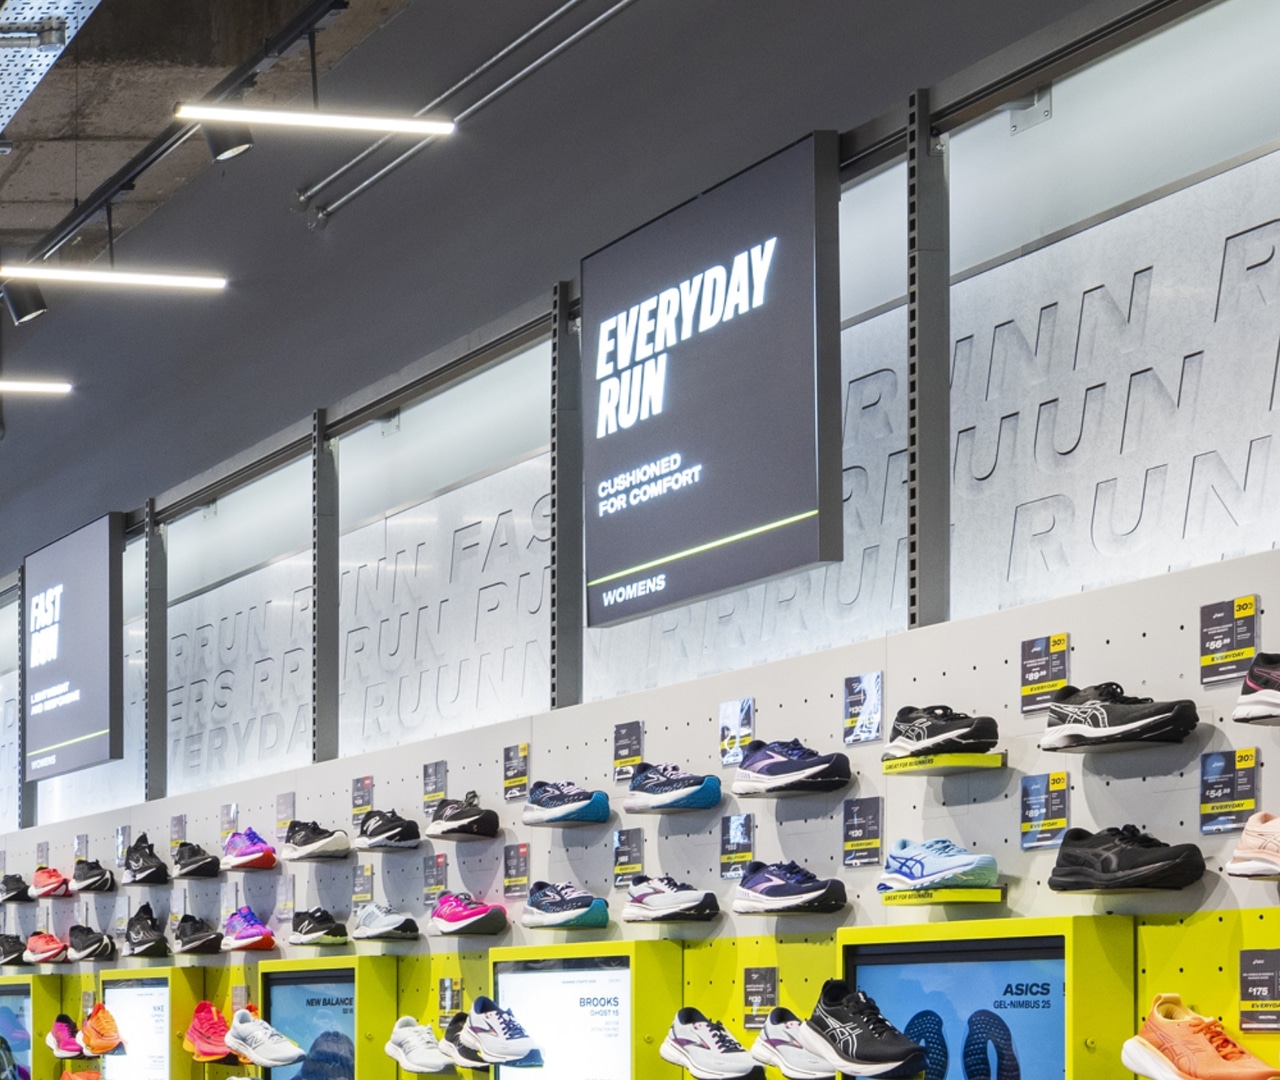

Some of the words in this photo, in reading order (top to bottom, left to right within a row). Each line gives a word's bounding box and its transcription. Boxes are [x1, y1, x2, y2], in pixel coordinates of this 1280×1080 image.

[596, 236, 778, 380] EVERYDAY
[596, 354, 668, 440] RUN
[597, 452, 682, 498] CUSHIONED
[598, 485, 637, 518] FOR
[637, 463, 703, 507] COMFORT
[602, 574, 667, 607] WOMENS
[1003, 983, 1051, 996] ASICS
[1247, 985, 1269, 996] £175
[306, 998, 321, 1007] NEW
[322, 997, 353, 1006] BALANCE
[579, 996, 619, 1008] BROOKS
[993, 1000, 1040, 1010] GEL-NIMBUS
[1041, 1000, 1051, 1009] 25
